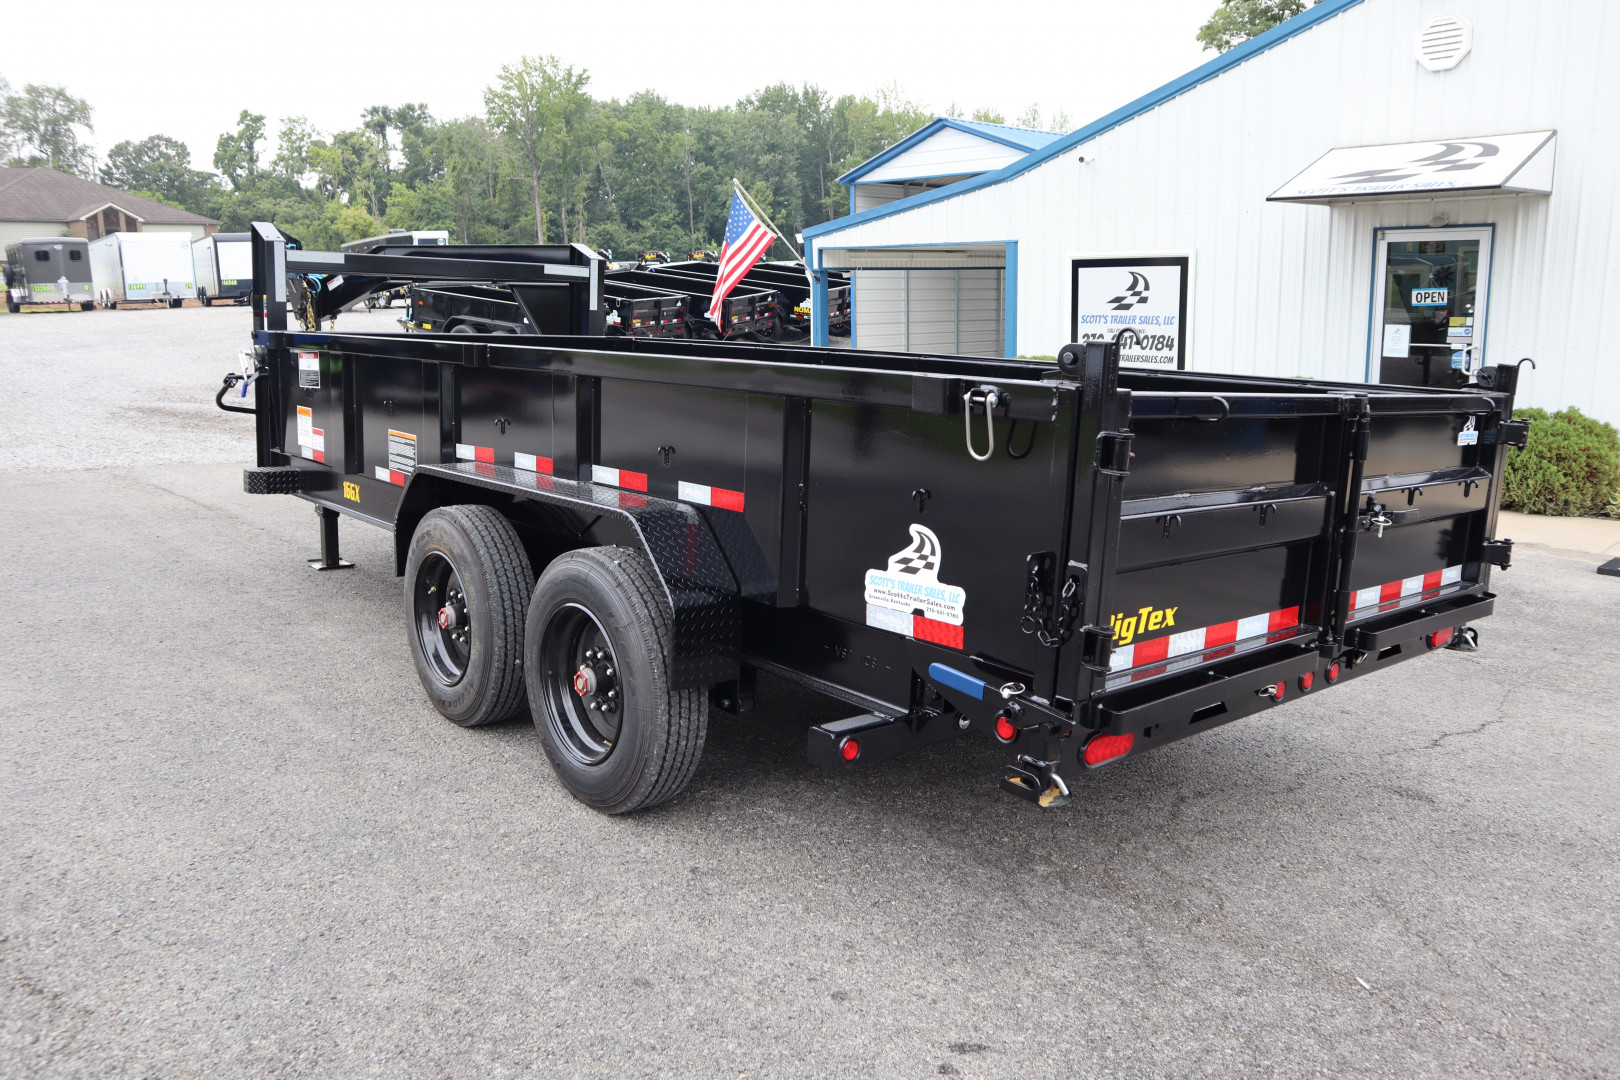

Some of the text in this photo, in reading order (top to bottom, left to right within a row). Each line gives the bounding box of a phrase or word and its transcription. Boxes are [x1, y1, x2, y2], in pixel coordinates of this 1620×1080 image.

[1415, 291, 1445, 303] OPEN
[1081, 315, 1176, 327] SCOTT'S TRAILER SALES, LLC
[1119, 354, 1174, 364] TRAILERSALES.COM
[869, 575, 961, 604] SCOTT'S TRAILER SALES, LLC
[873, 588, 956, 611] www.ScottsTrailerSales.com
